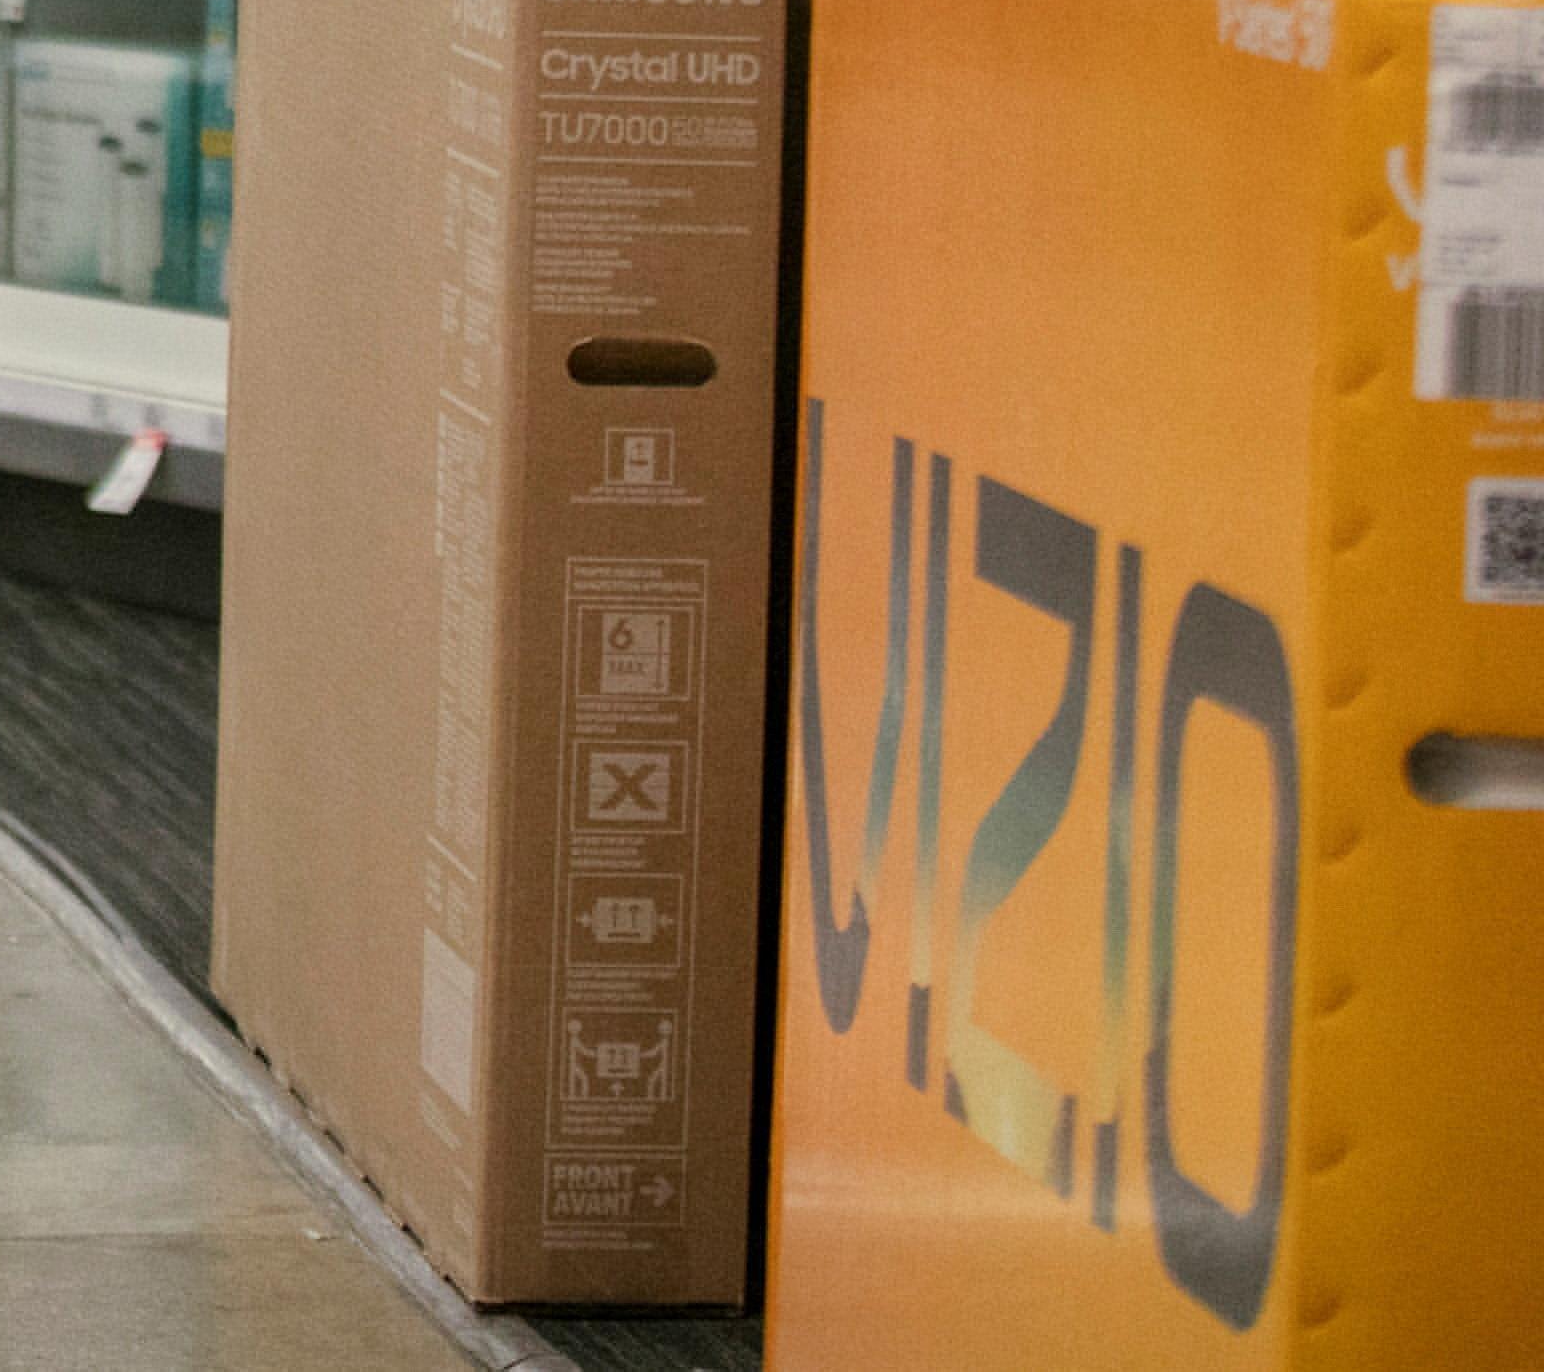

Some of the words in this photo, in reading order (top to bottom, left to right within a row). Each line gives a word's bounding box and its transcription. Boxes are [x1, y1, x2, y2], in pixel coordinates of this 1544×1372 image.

[540, 48, 680, 92] Crystal
[687, 52, 762, 86] UHD
[536, 111, 670, 147] TU7000
[608, 618, 634, 650] 6
[801, 397, 1301, 1336] VIZIO
[552, 1164, 637, 1191] FRONT
[553, 1190, 634, 1216] AVANT
